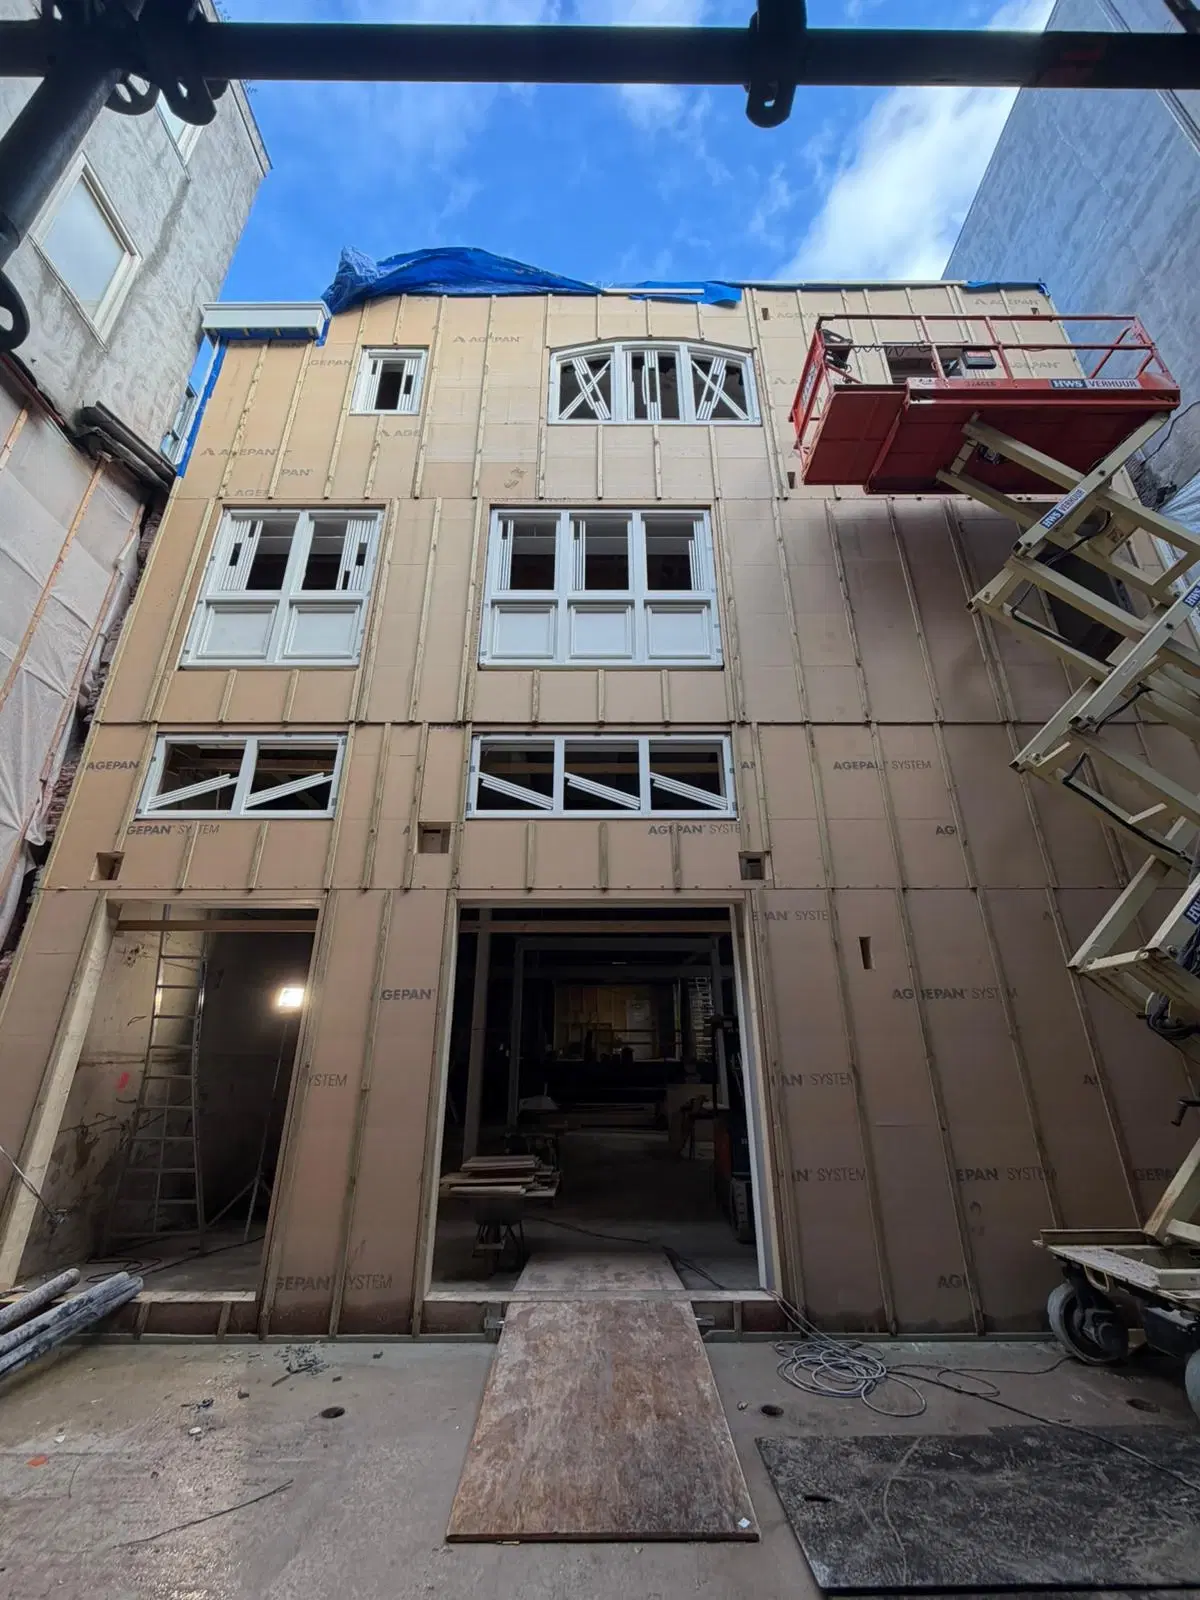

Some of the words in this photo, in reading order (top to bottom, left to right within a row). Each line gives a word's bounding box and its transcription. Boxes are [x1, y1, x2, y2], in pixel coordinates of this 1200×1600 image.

[1052, 380, 1084, 388] HWS
[1087, 380, 1138, 388] VERHUUR
[1043, 509, 1064, 529] HWS
[1060, 488, 1086, 512] VERHUUR
[891, 760, 932, 770] SYSTEM
